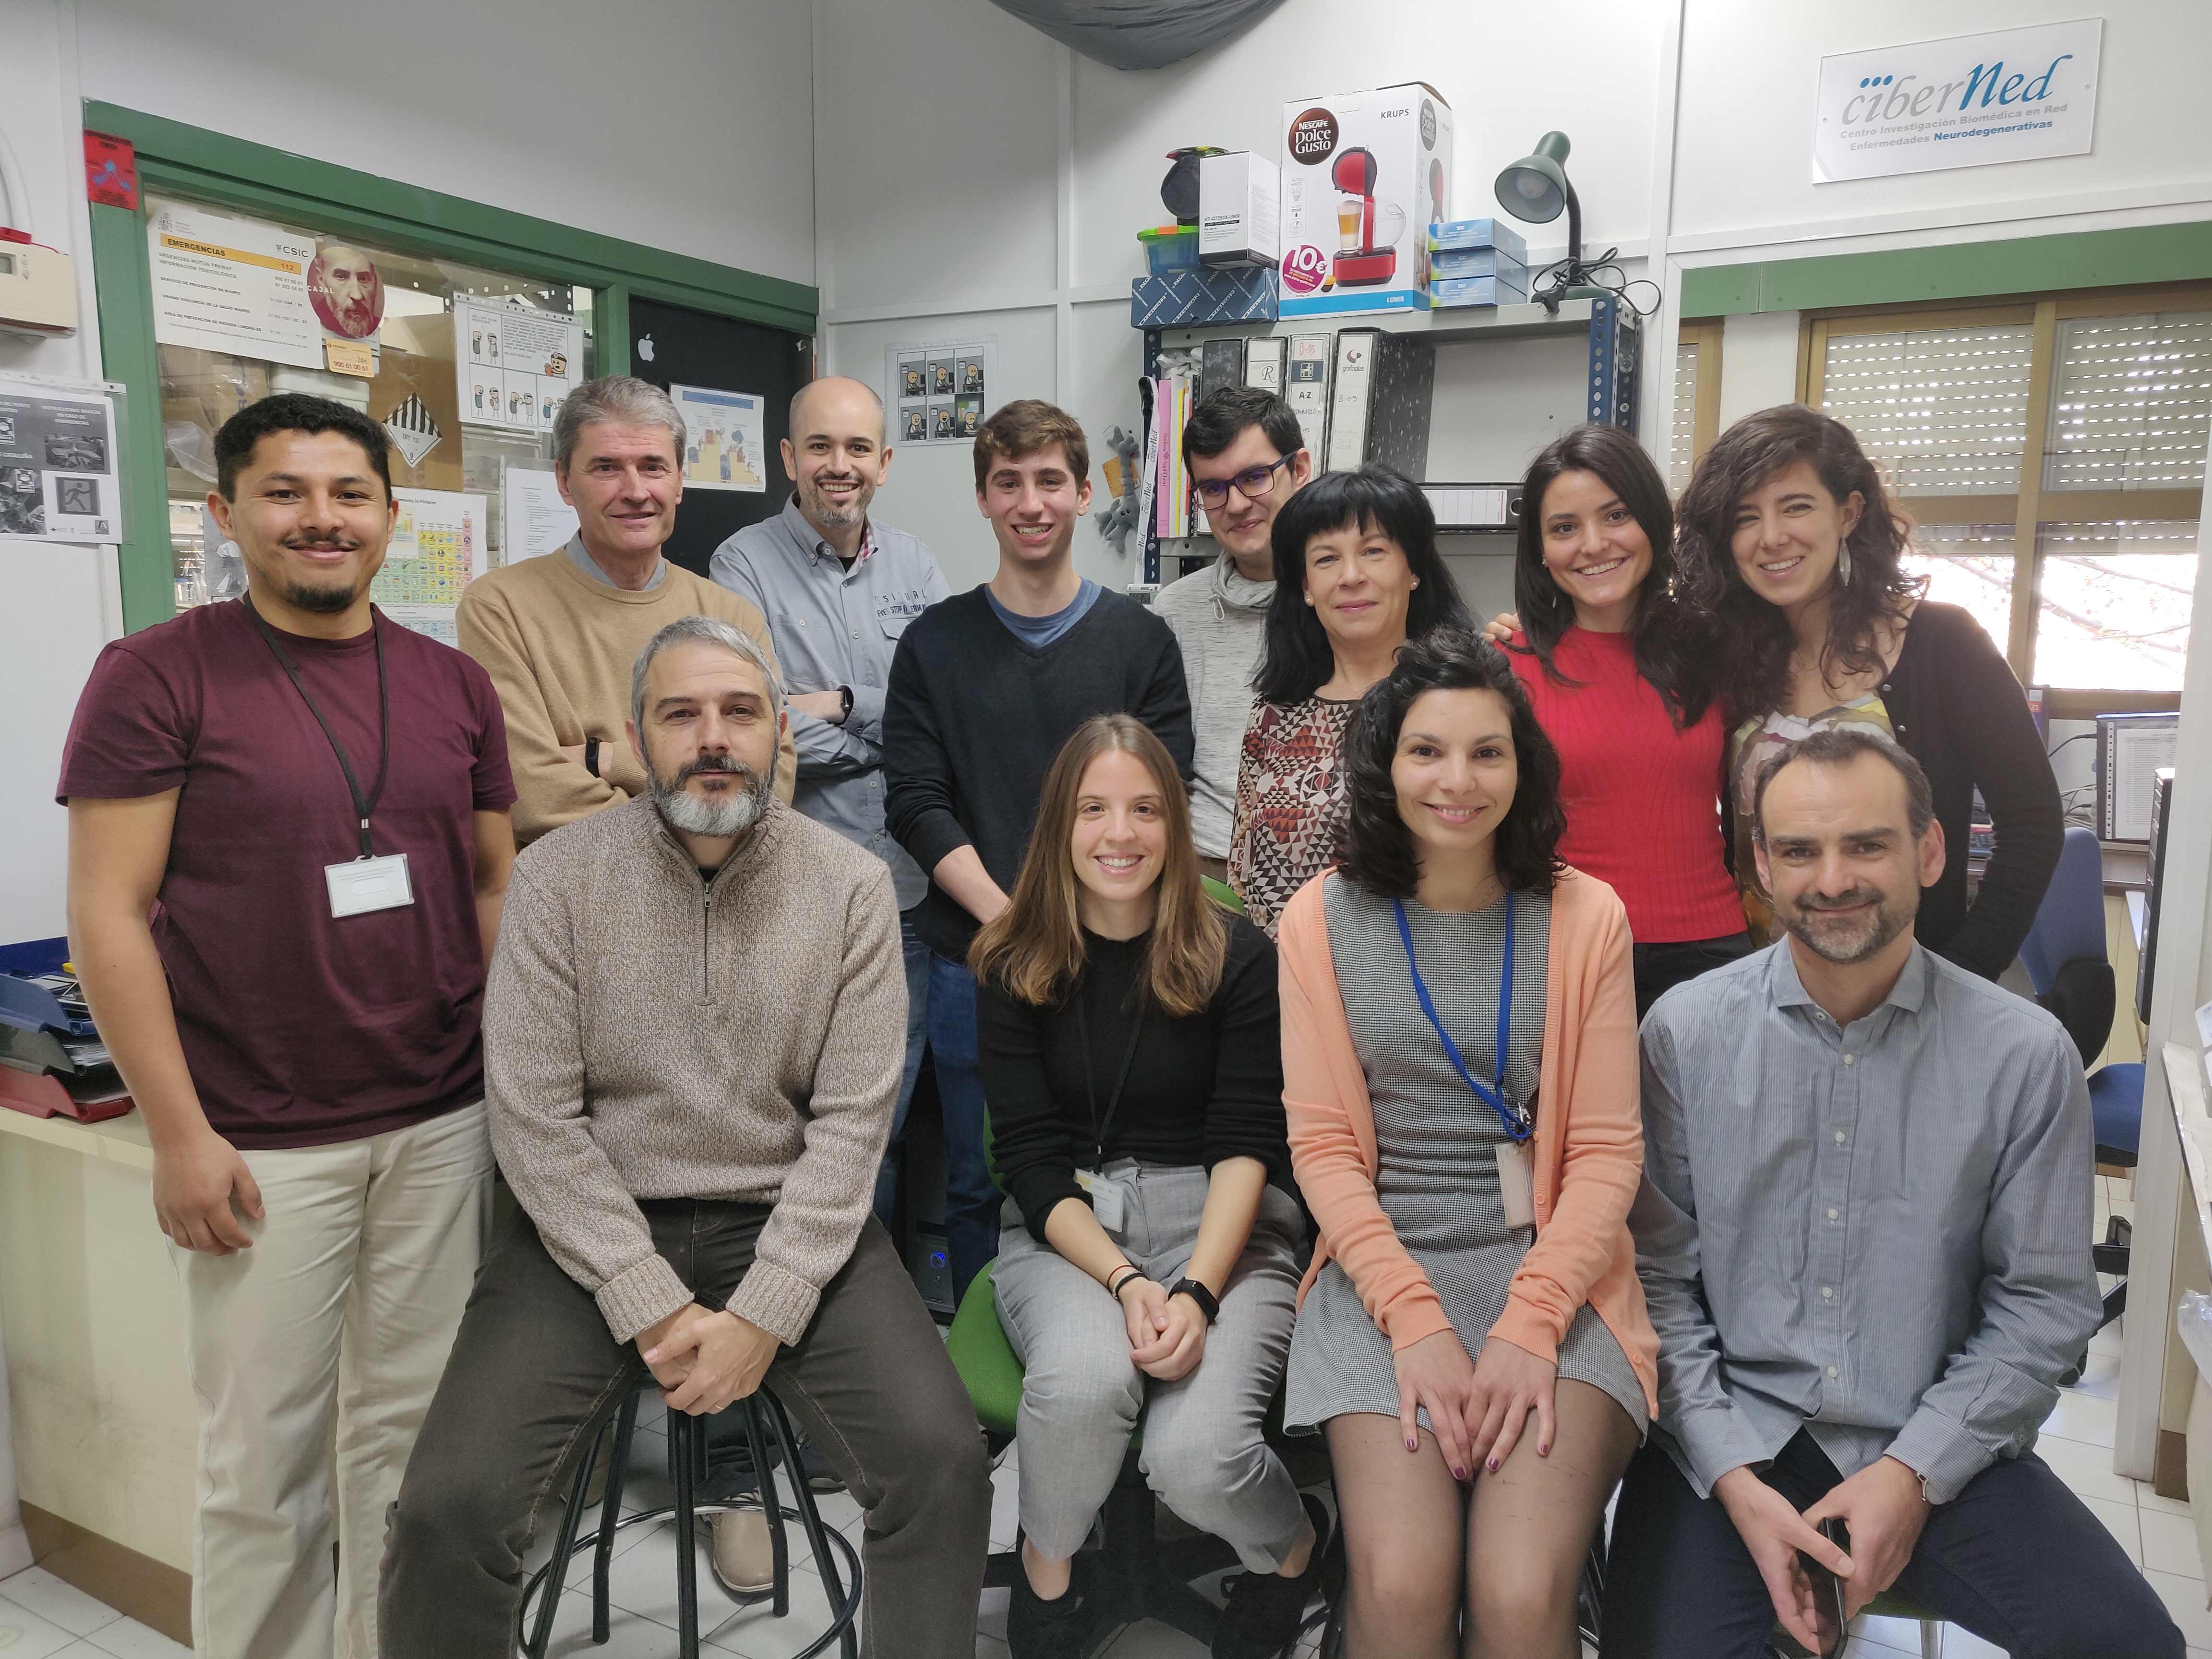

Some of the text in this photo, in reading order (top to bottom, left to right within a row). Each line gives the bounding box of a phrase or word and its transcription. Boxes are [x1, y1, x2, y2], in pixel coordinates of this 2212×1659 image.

[1381, 108, 1410, 119] KRUPS
[1840, 103, 2068, 139] Centro Investigación Biomédica en Red
[1295, 129, 1331, 144] Dolce
[1850, 120, 2053, 151] Enfermedades Neurodegenerativas
[1295, 140, 1331, 154] Gusto
[168, 238, 226, 256] EMERGENCIAS
[283, 246, 308, 258] CSIC
[159, 252, 190, 262] URGENCIAS
[307, 285, 335, 294] CAJAL
[1299, 342, 1316, 356] B-05
[890, 605, 902, 613] STOP
